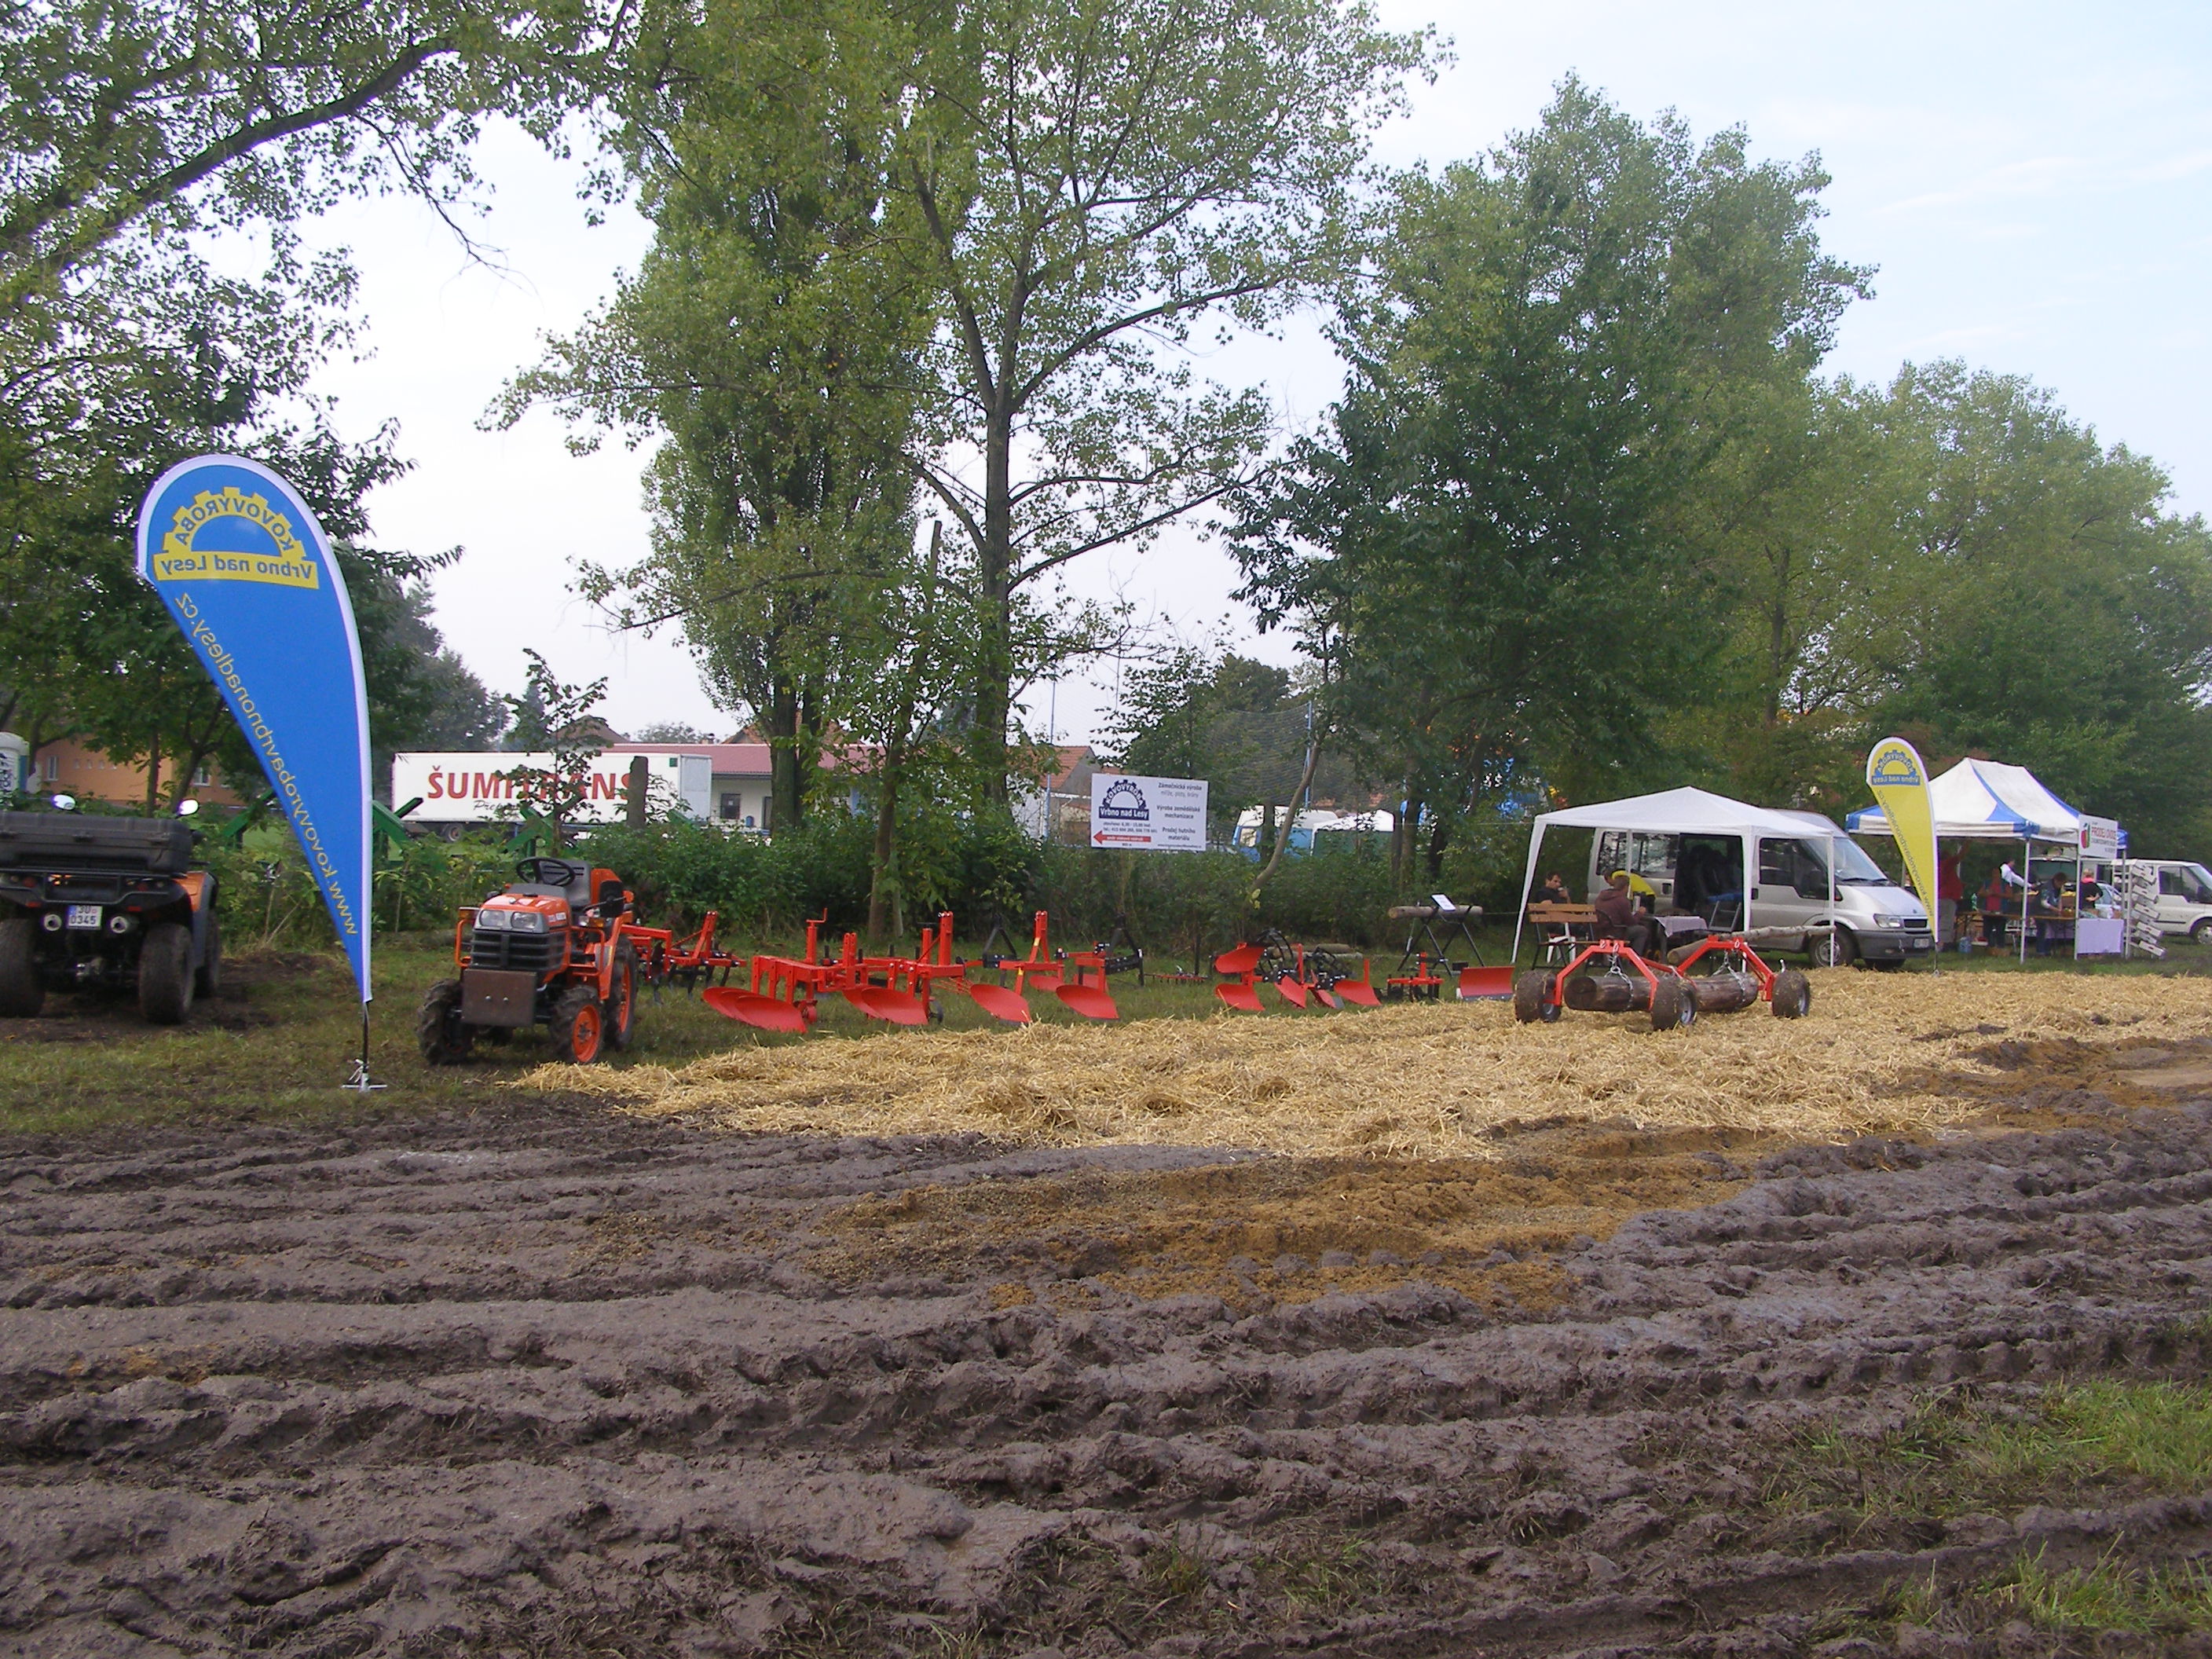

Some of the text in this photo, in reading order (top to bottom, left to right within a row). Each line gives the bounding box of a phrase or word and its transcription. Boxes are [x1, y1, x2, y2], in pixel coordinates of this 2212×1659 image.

[1105, 783, 1143, 806] KOVOVYROBA
[1100, 808, 1148, 819] Vrbno nad Lesy
